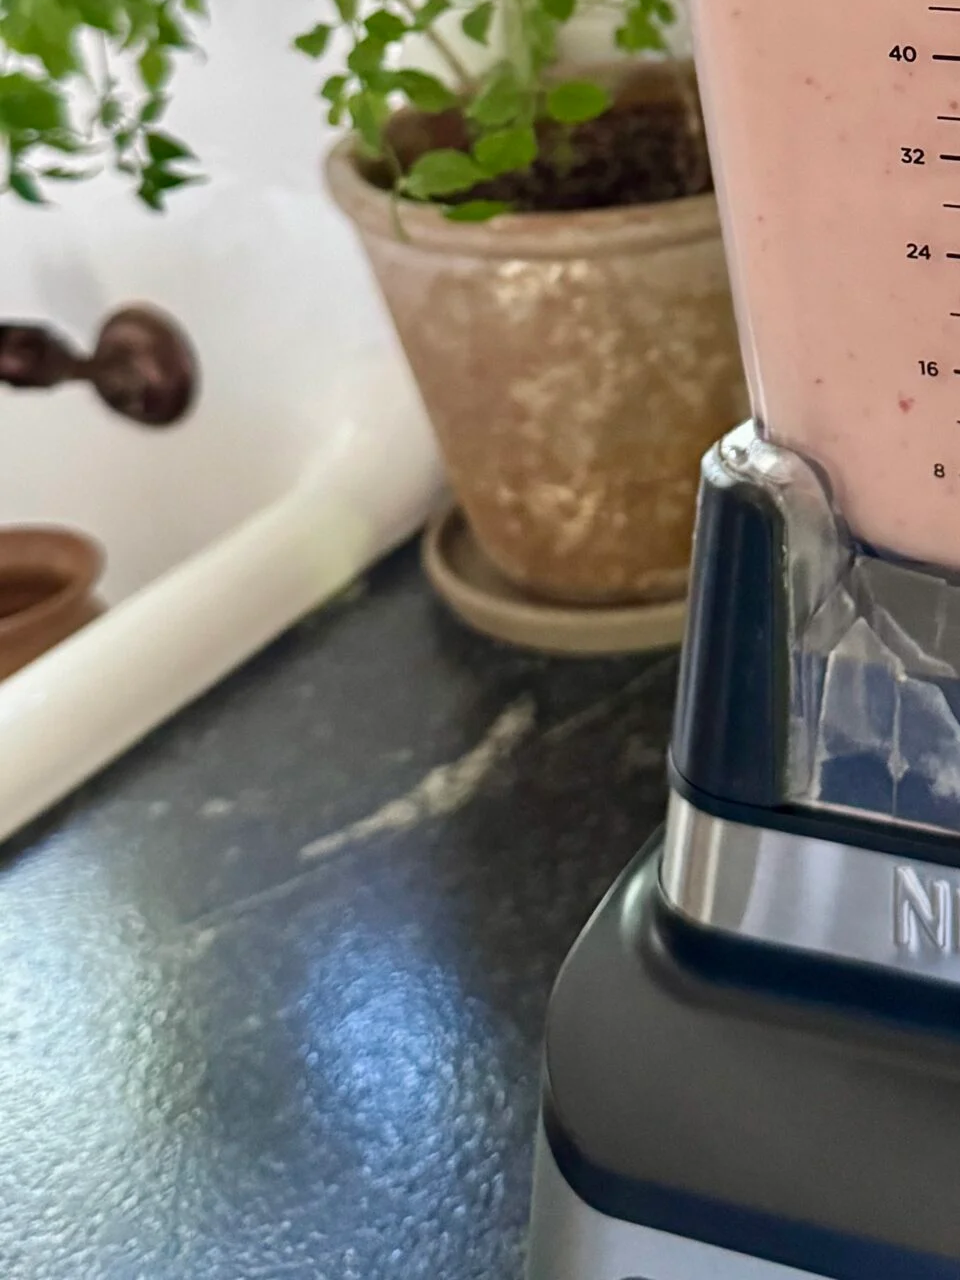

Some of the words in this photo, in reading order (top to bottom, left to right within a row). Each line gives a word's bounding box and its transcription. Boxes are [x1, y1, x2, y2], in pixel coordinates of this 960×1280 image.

[888, 44, 917, 63] 40
[900, 146, 926, 166] 32
[906, 242, 932, 261] 24
[917, 360, 940, 378] 16
[933, 463, 946, 479] 8
